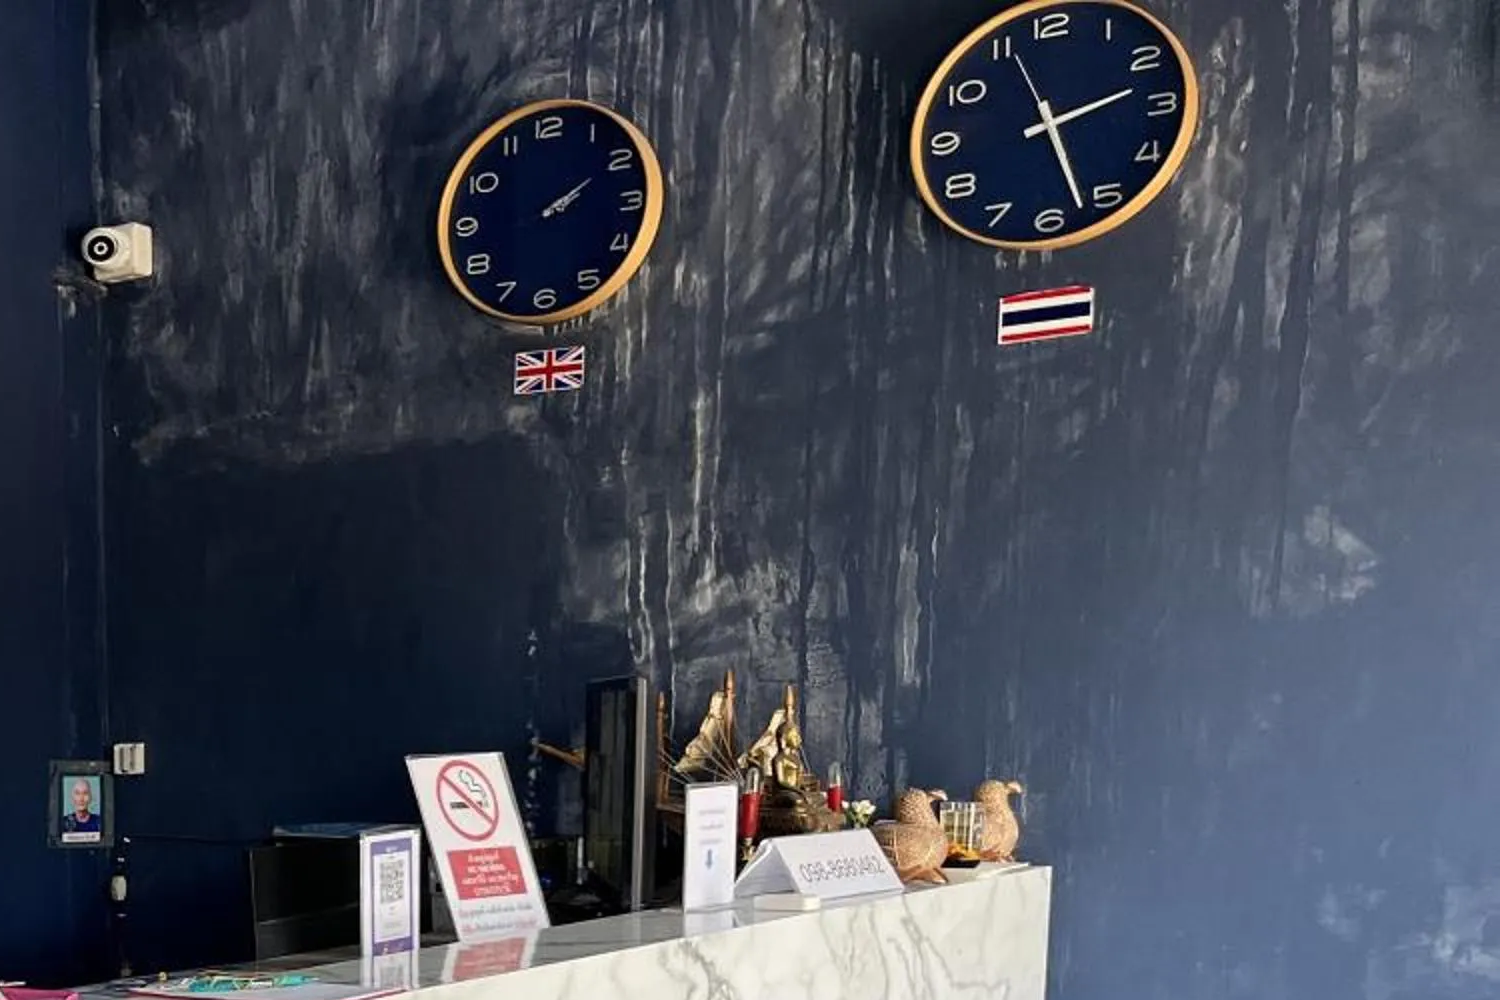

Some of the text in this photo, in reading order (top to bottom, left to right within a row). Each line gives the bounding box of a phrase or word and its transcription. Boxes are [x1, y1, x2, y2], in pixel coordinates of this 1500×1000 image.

[1033, 12, 1070, 40] 12
[1105, 18, 1112, 41] 1
[992, 35, 1011, 61] 11
[1129, 45, 1162, 72] 2
[948, 79, 987, 107] 10
[1147, 91, 1178, 117] 3
[535, 116, 564, 139] 12
[589, 123, 596, 143] 1
[503, 135, 518, 157] 11
[931, 131, 961, 156] 9
[1134, 140, 1161, 164] 4
[608, 148, 633, 171] 2
[469, 171, 499, 195] 10
[945, 173, 977, 199] 8
[619, 189, 643, 212] 3
[1093, 183, 1123, 209] 5
[984, 202, 1013, 228] 7
[1034, 208, 1065, 233] 6
[455, 216, 479, 238] 9
[609, 232, 629, 253] 4
[466, 253, 490, 275] 8
[577, 268, 600, 290] 5
[495, 280, 517, 302] 7
[533, 288, 556, 309] 6
